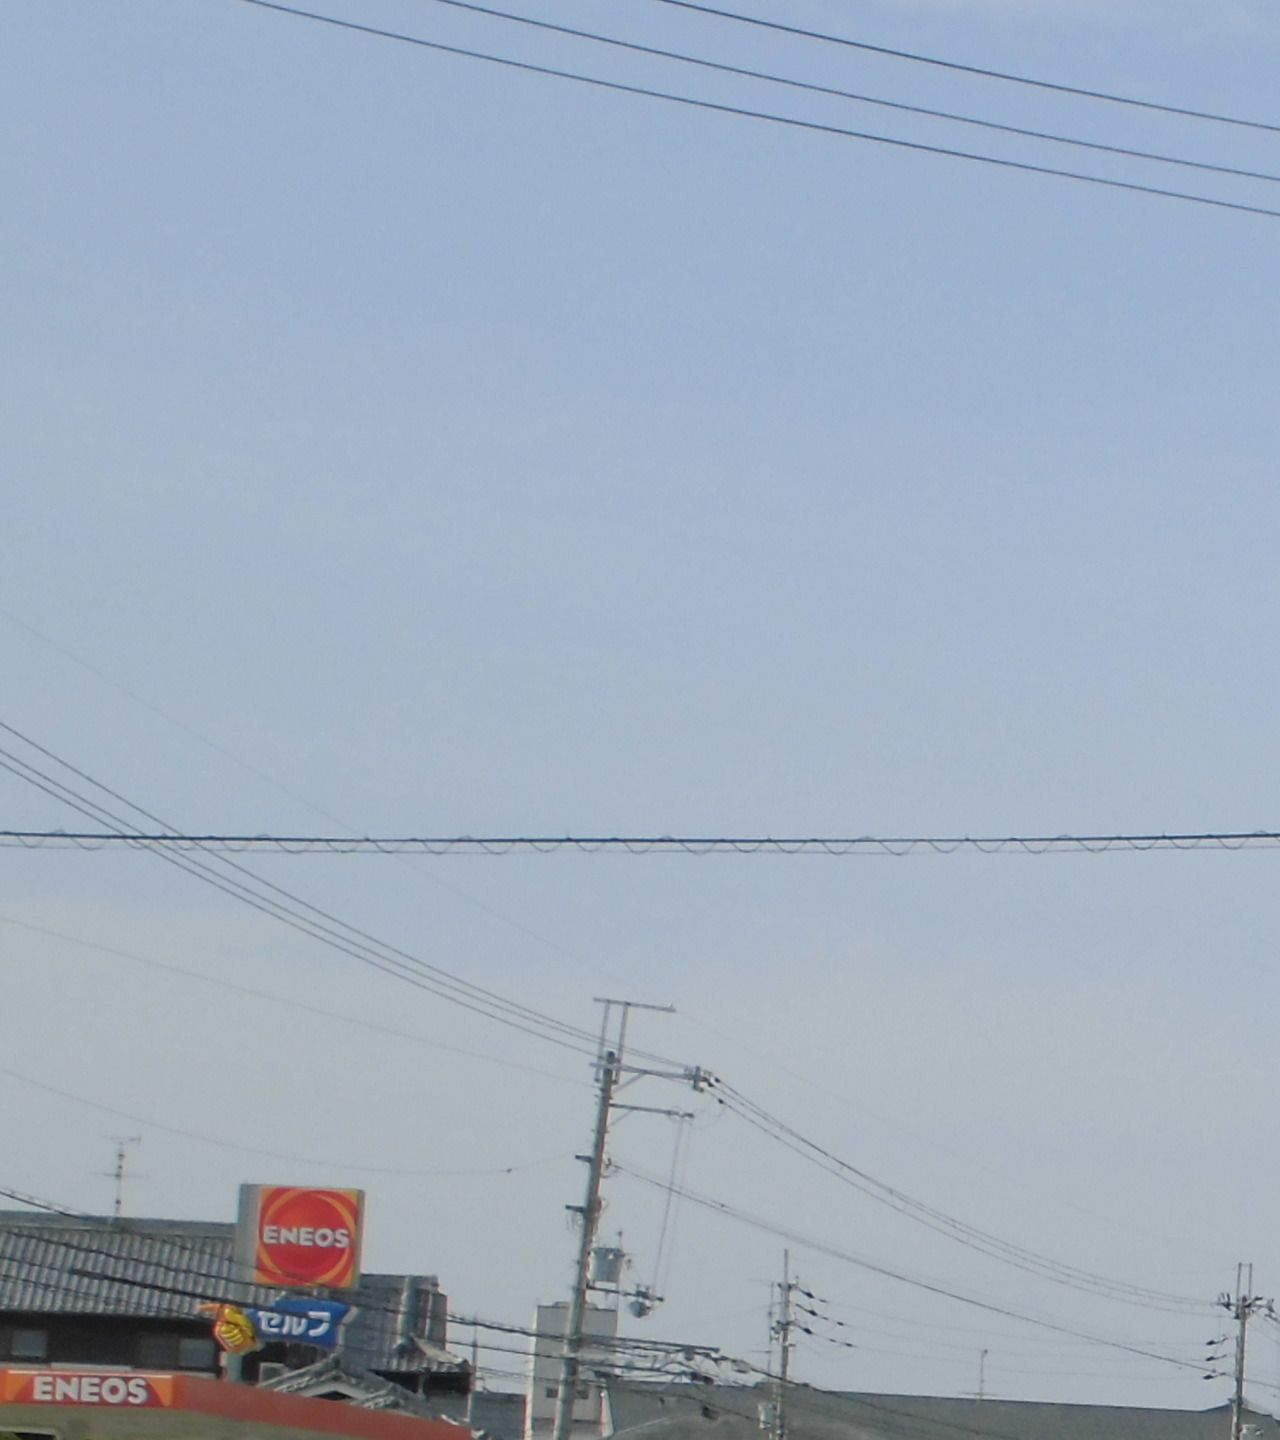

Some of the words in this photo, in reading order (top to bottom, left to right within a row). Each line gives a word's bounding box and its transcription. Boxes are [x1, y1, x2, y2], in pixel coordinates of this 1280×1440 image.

[262, 1225, 349, 1249] ENEOS
[258, 1310, 331, 1337] セルフ
[33, 1376, 149, 1405] ENEOS
